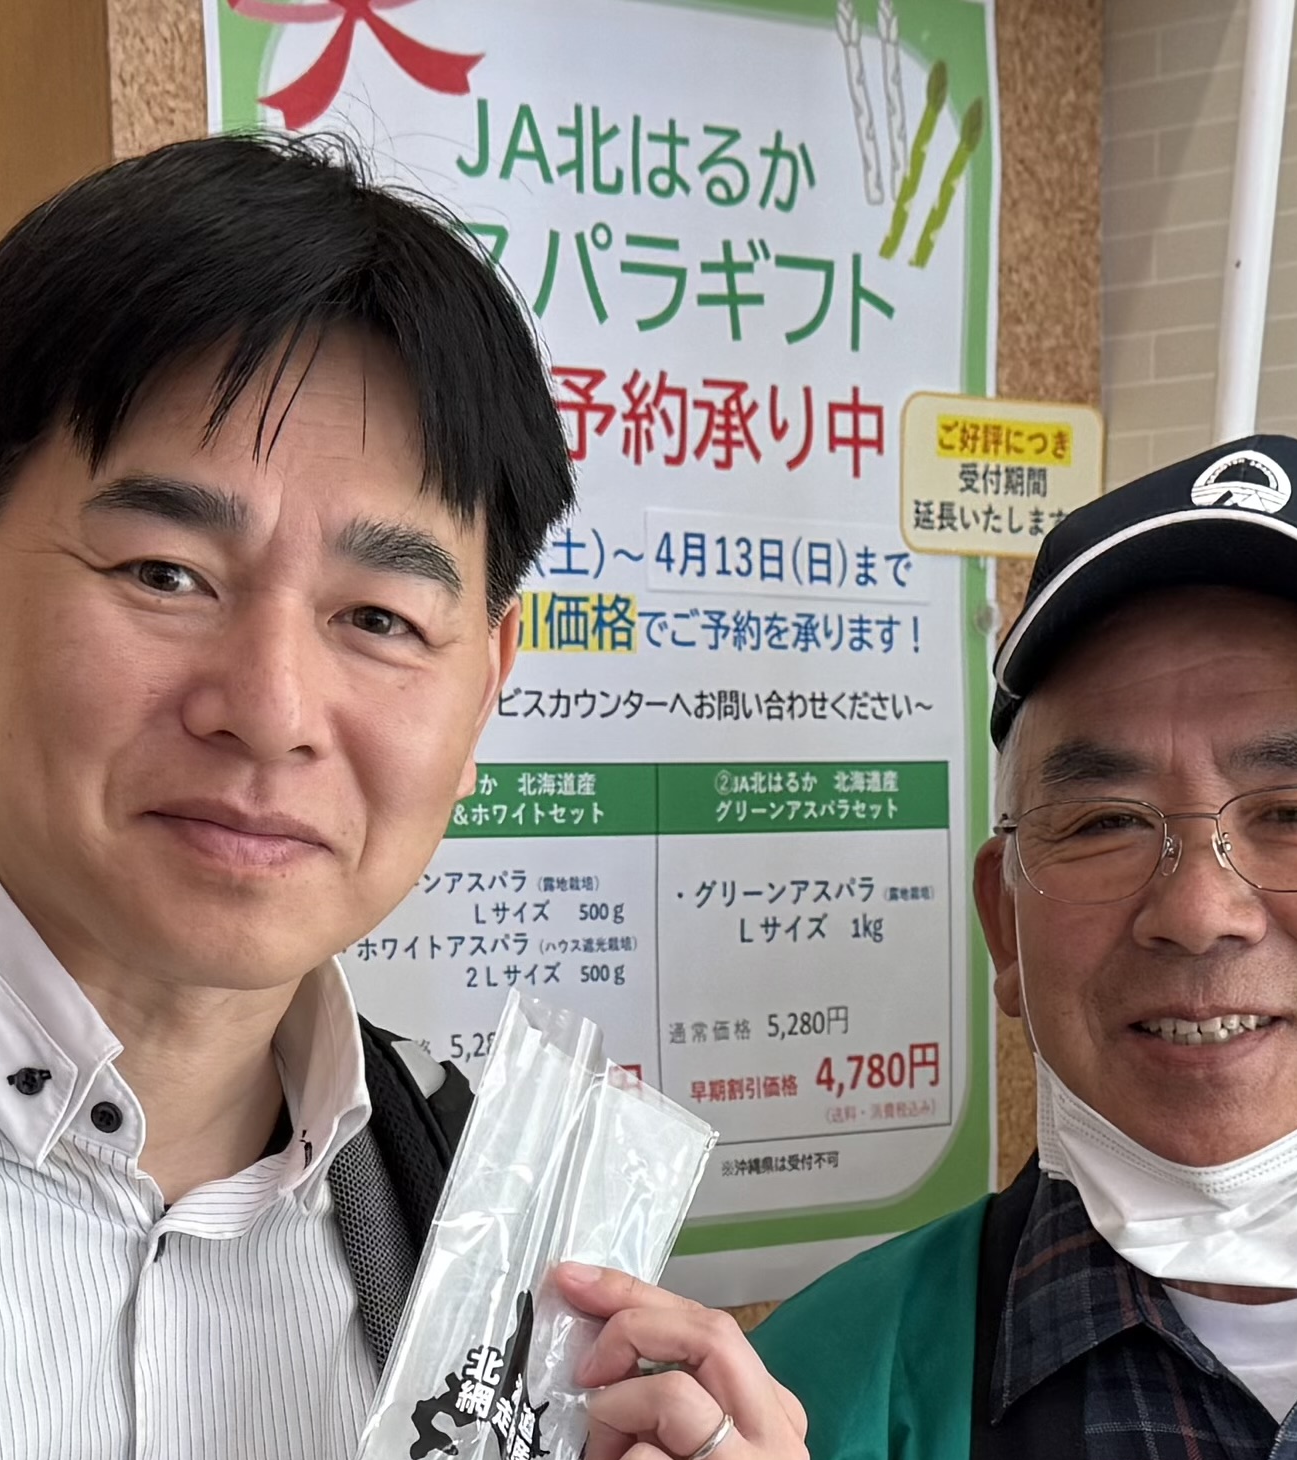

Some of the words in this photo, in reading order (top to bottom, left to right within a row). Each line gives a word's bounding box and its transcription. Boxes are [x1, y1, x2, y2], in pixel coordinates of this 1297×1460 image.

[454, 99, 817, 213] JA北はるか
[551, 364, 886, 480] 予約承り中
[937, 419, 1071, 460] ご好評につき
[958, 462, 1049, 498] 受付期間
[517, 771, 596, 797] 北海道産
[834, 769, 900, 794] 北海道産
[715, 799, 899, 823] グリーンアスパラセット
[413, 870, 528, 895] ンアスパラ
[851, 911, 884, 943] 1kg
[669, 1018, 751, 1046] 通常価格
[767, 1005, 849, 1041] 5,280円
[690, 1074, 798, 1103] 早期割引価格
[815, 1042, 940, 1099] 4,780円
